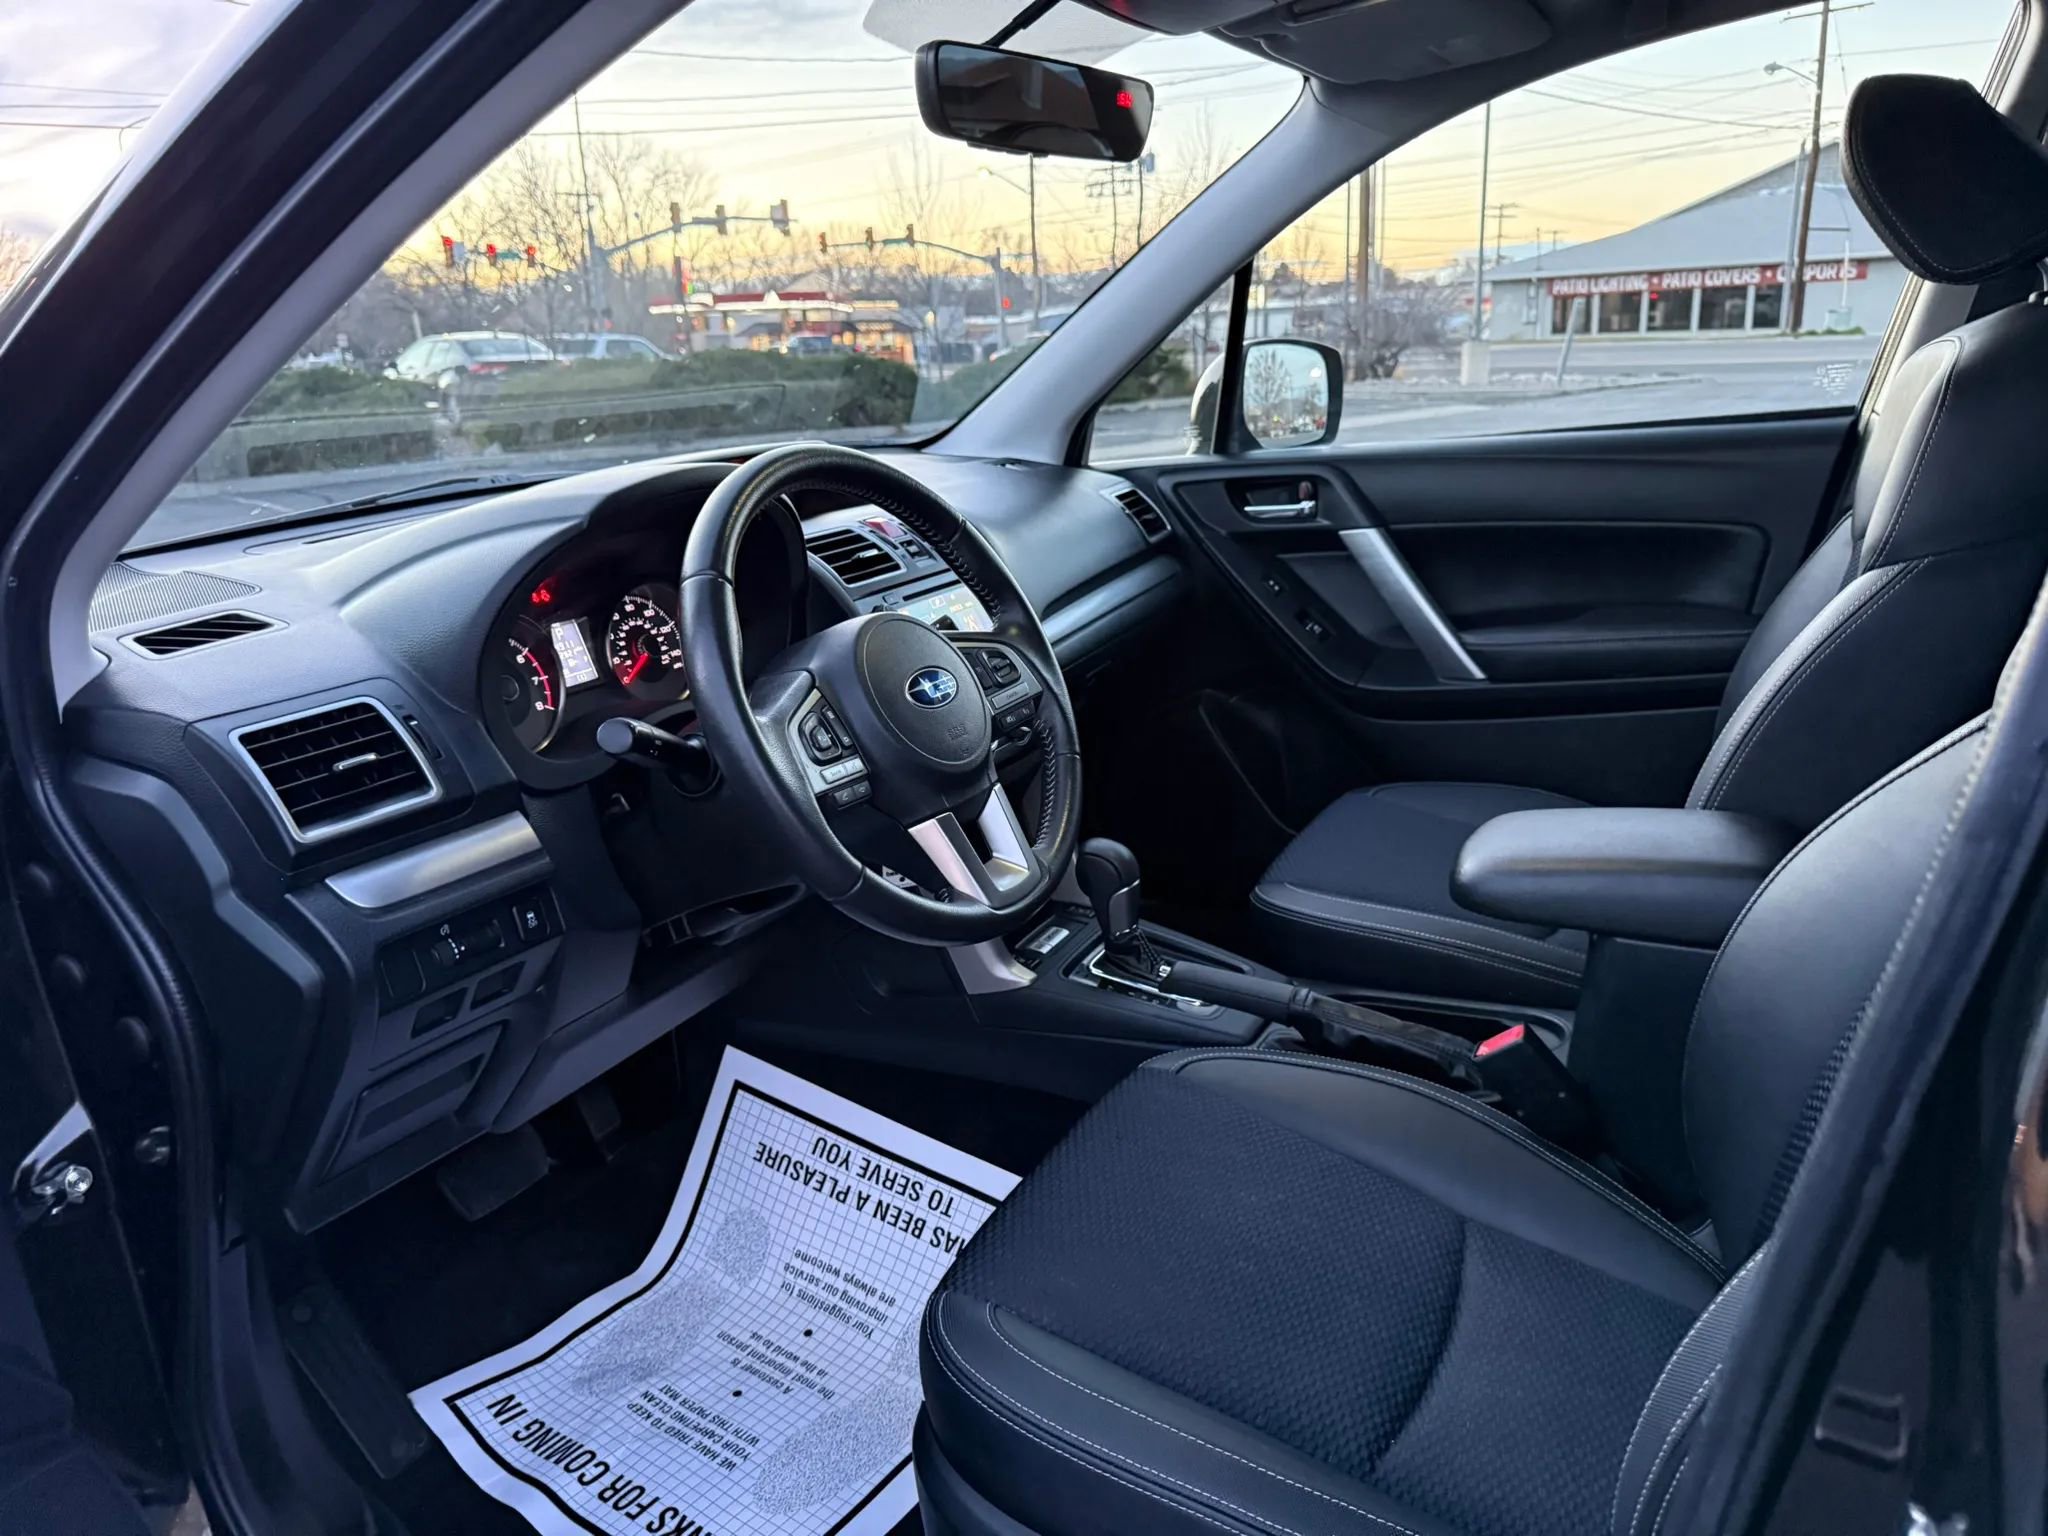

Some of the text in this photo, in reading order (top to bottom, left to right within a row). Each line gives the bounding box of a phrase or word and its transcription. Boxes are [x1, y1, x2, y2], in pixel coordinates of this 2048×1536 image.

[1552, 277, 1589, 295] PATIO
[1590, 273, 1648, 294] LIGHTING
[1661, 270, 1702, 289] PATIO
[1704, 267, 1761, 287] COVERS
[516, 654, 526, 664] 6
[531, 676, 539, 685] 7
[535, 701, 544, 711] 8
[753, 1141, 851, 1204] PLEASURE
[811, 1137, 954, 1218] TO SERVE YOU
[856, 1190, 871, 1212] A
[872, 1199, 926, 1240] BEEN
[783, 1262, 888, 1326] improving our service
[842, 1272, 877, 1297] always
[780, 1280, 874, 1340] Your suggestions for
[878, 1292, 896, 1308] are
[762, 1339, 774, 1350] to
[771, 1344, 800, 1364] world
[716, 1330, 835, 1400] the most important person
[740, 1362, 785, 1389] customer
[800, 1359, 817, 1374] the
[816, 1368, 828, 1379] in
[783, 1385, 794, 1395] A
[486, 1394, 529, 1426] IN
[659, 1384, 760, 1447] WITH THIS PAPER MAT
[626, 1402, 737, 1472] WE HAVE TRIED TO KEEP
[640, 1390, 752, 1462] YOUR CARPETING CLEAN
[512, 1417, 610, 1487] COMING
[597, 1474, 660, 1521] FOR
